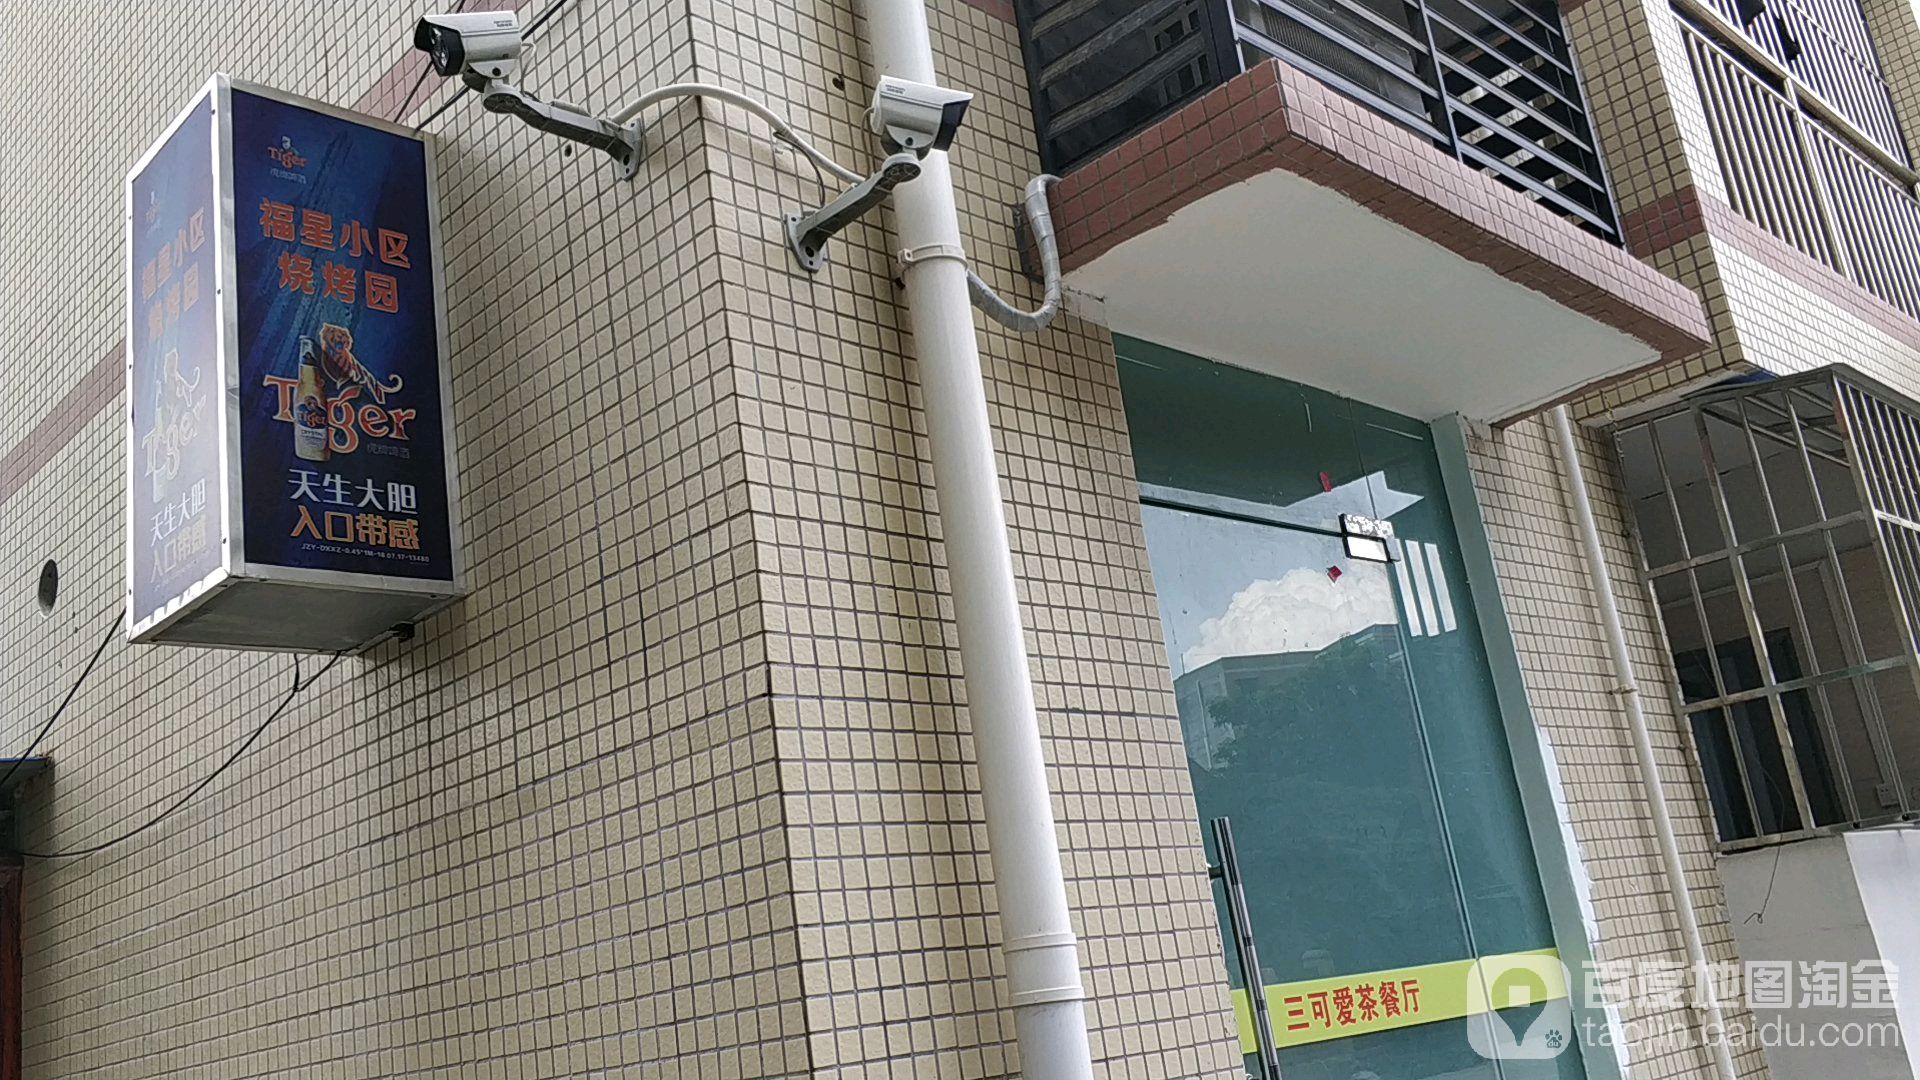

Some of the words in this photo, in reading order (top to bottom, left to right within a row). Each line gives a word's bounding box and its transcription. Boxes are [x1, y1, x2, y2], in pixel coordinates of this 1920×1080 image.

[267, 147, 308, 168] Tiger
[259, 197, 411, 268] 福星小区
[278, 251, 398, 313] 烧烤园
[141, 395, 206, 480] Tger
[263, 374, 416, 453] Tger
[150, 478, 206, 547] 天生大胆
[288, 468, 418, 514] 天生大胆
[290, 505, 420, 550] 入口带感
[1284, 979, 1420, 1031] 三可愛茶餐厅
